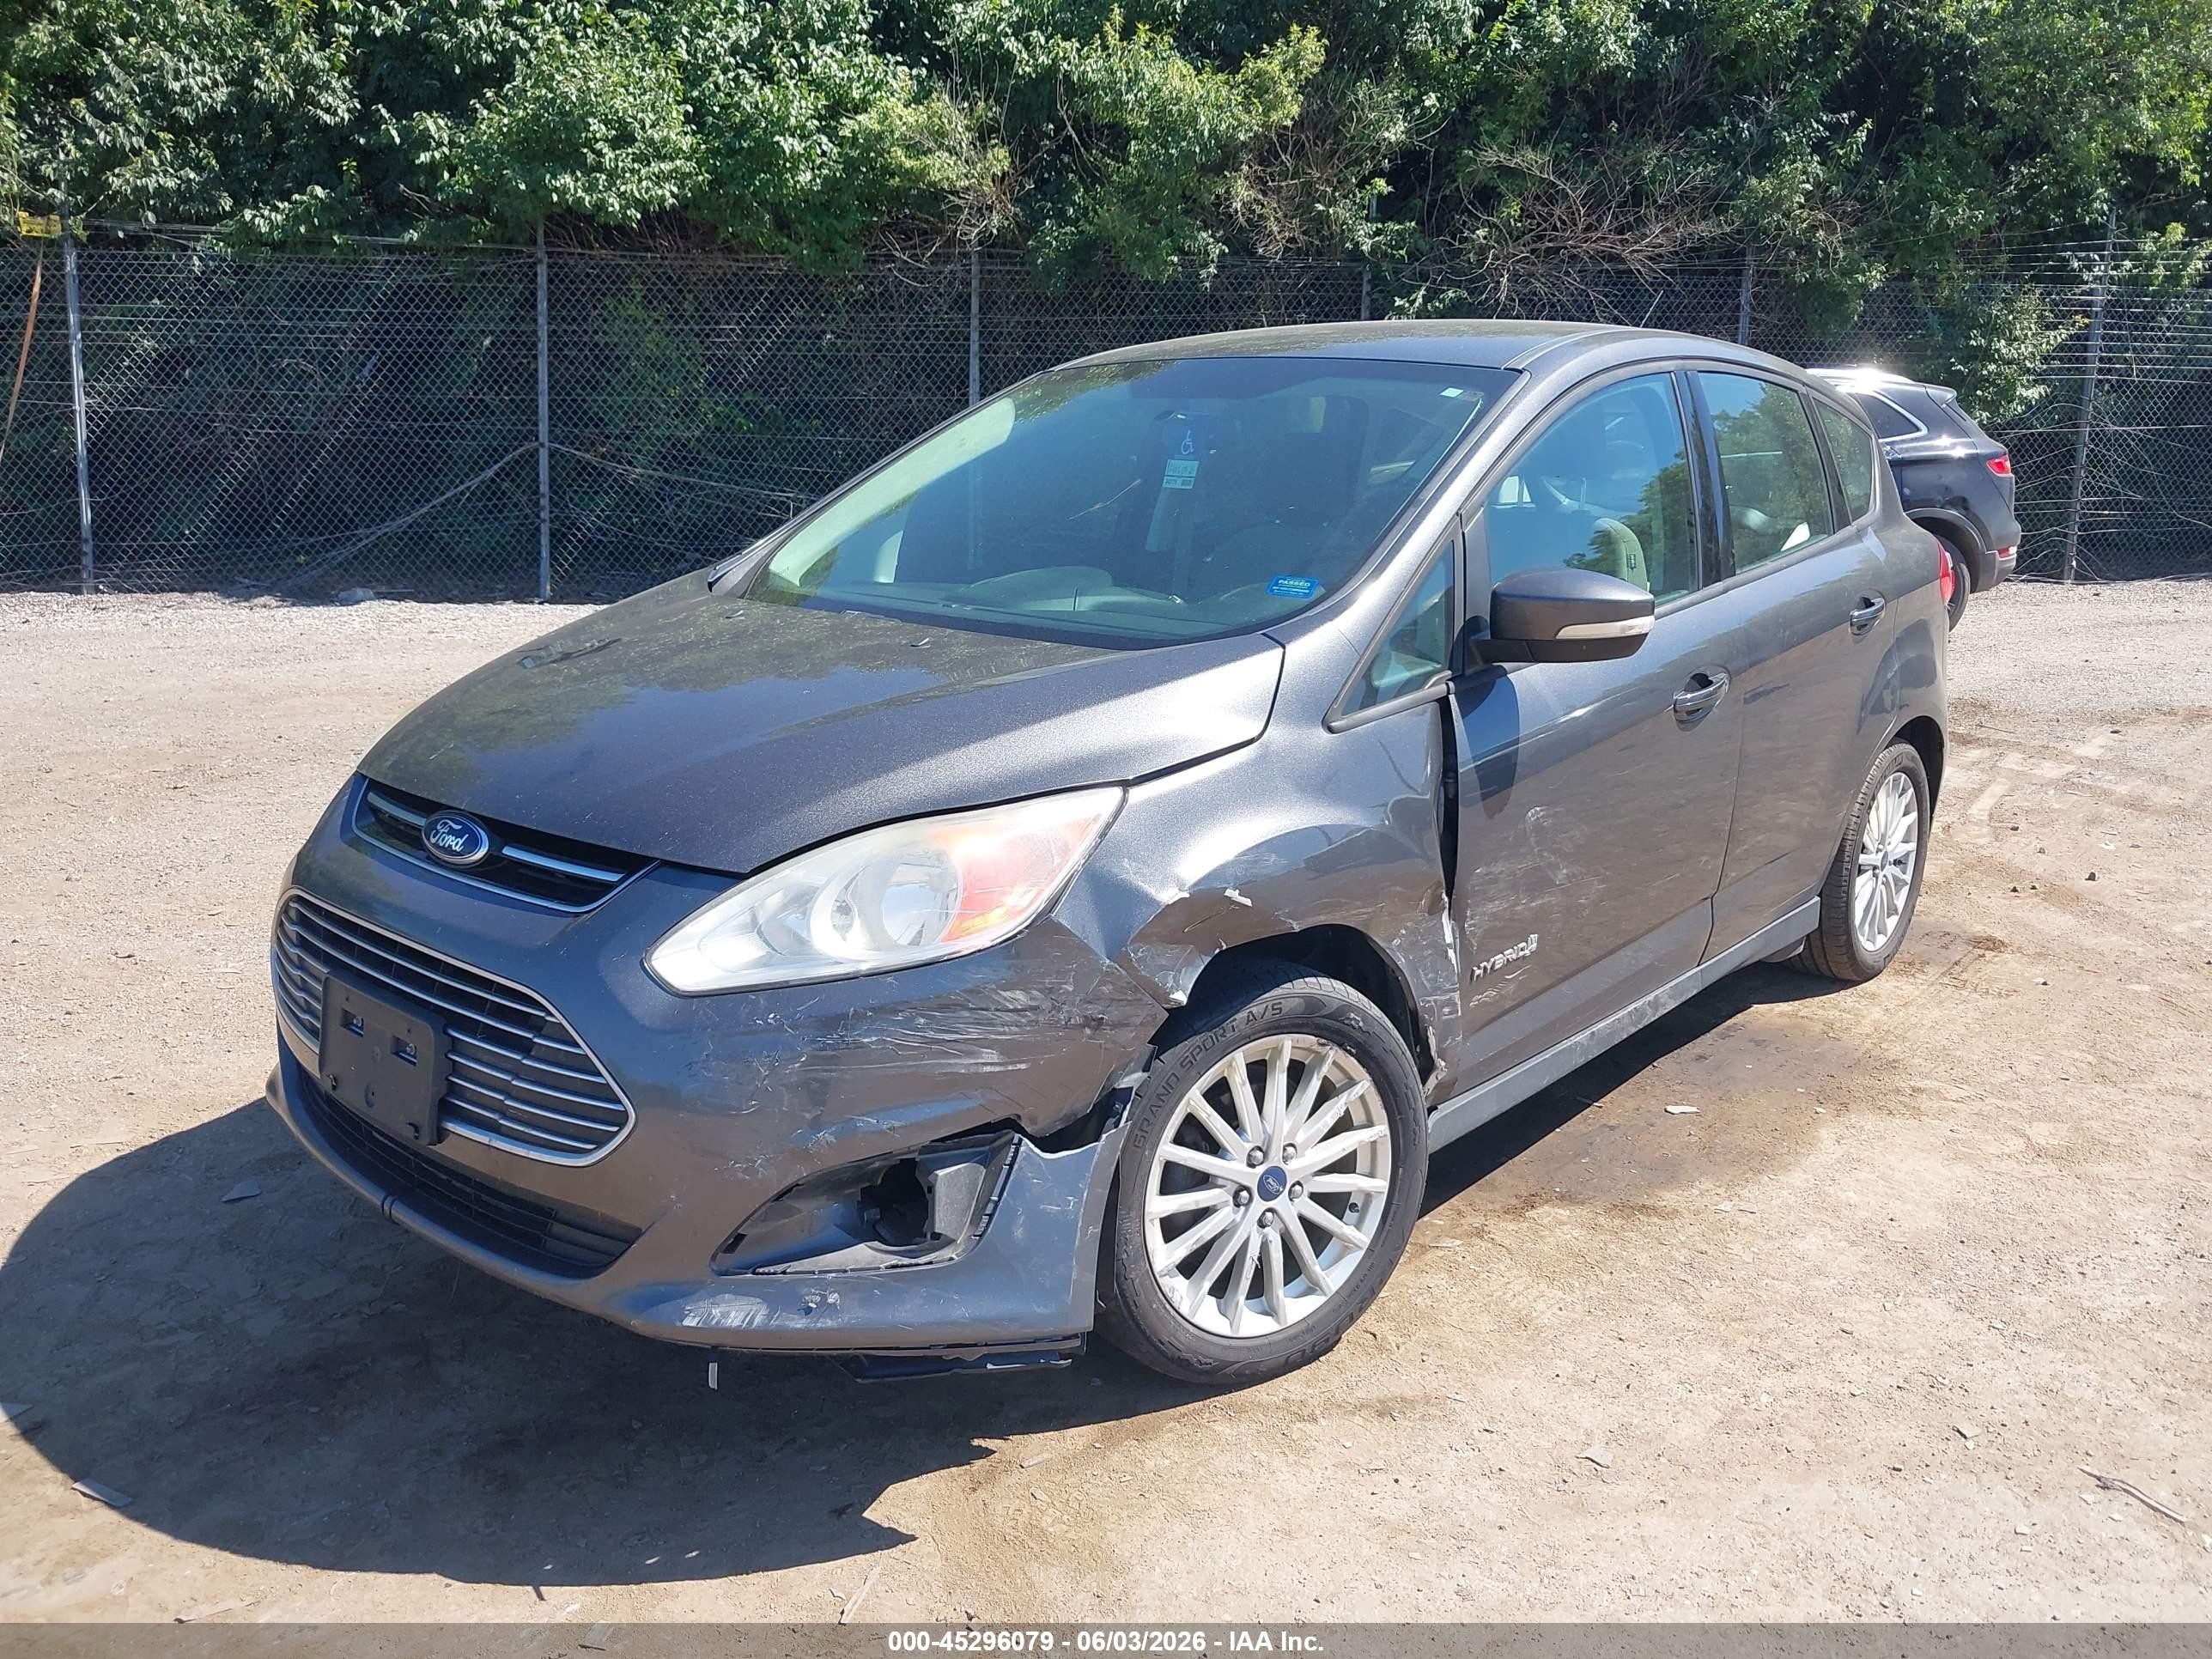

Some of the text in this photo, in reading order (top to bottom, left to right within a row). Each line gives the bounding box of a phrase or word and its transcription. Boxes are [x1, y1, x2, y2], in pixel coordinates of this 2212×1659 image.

[430, 819, 469, 852] Ford
[1471, 941, 1529, 982] HYBRID
[1133, 1001, 1283, 1149] GRAND SPORT A/S
